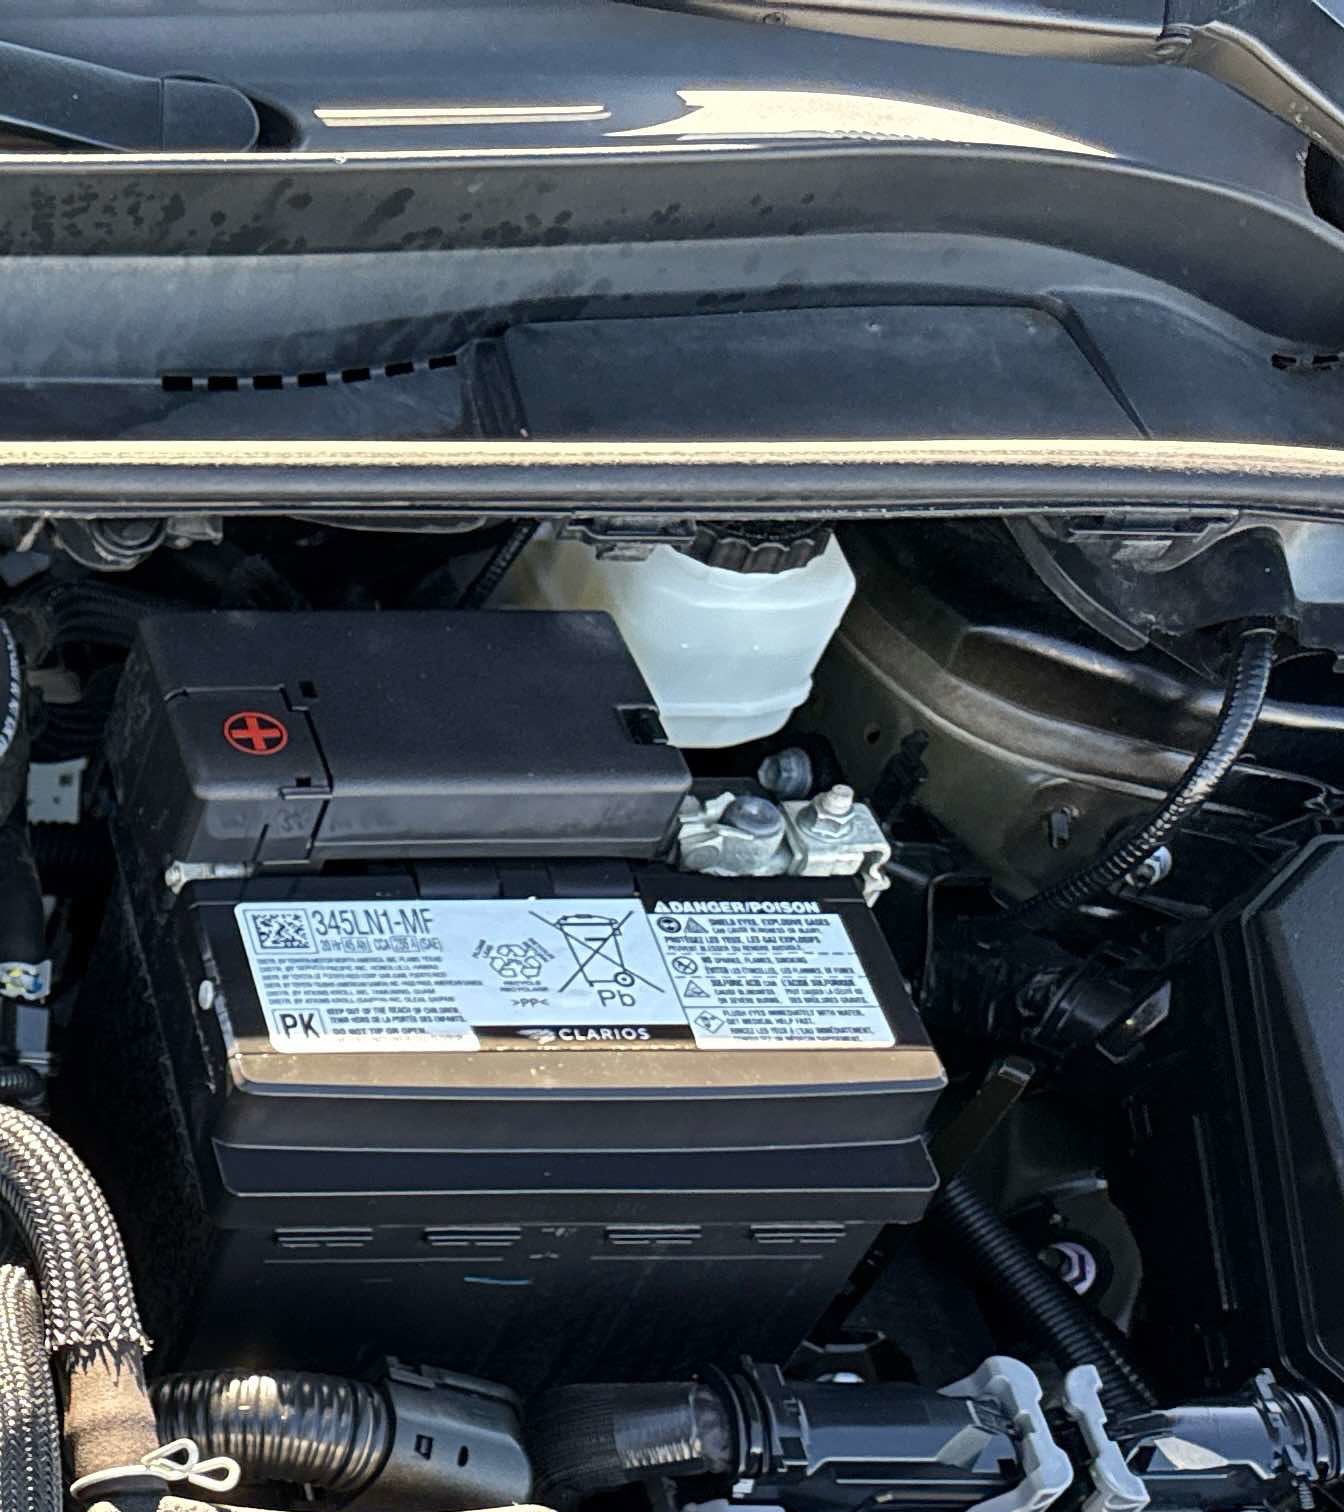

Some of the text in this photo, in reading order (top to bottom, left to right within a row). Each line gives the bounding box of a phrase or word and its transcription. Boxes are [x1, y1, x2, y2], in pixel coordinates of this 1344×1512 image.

[668, 901, 820, 913] DANGER/POISON
[312, 908, 433, 935] 345LN1-MF
[597, 989, 636, 1007] Pb
[279, 1012, 320, 1039] PK
[559, 1028, 650, 1041] CLARIOS
